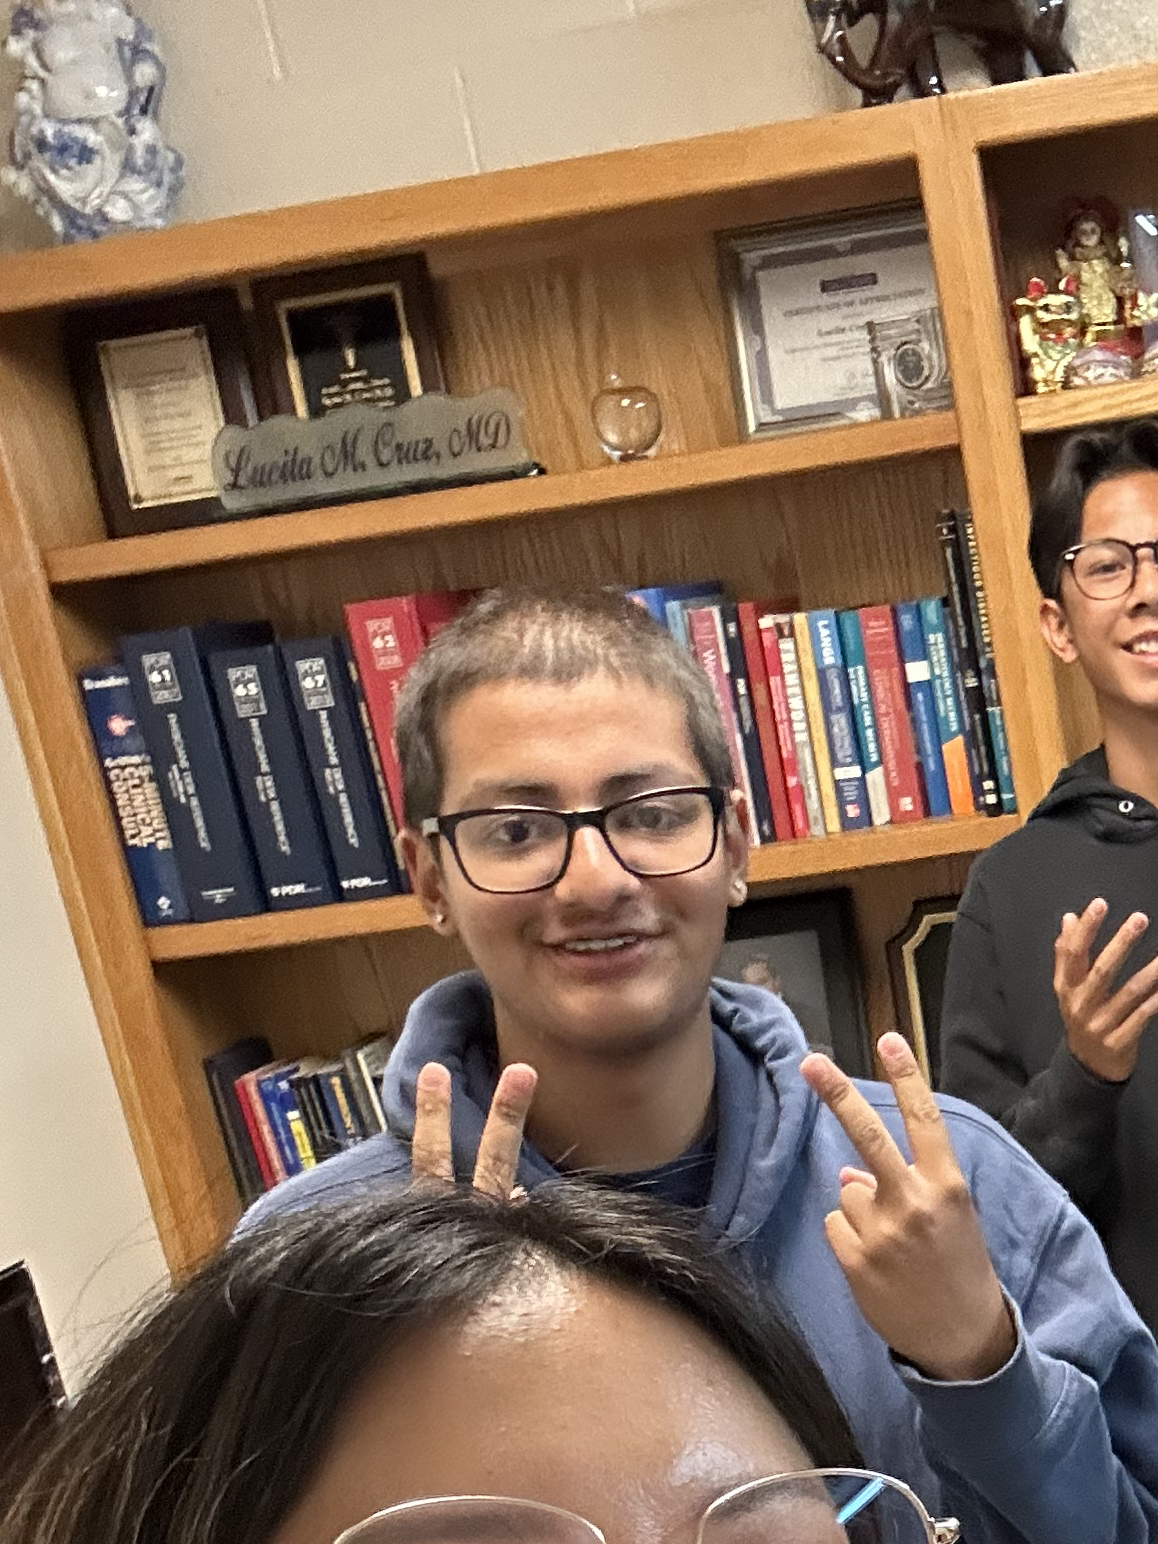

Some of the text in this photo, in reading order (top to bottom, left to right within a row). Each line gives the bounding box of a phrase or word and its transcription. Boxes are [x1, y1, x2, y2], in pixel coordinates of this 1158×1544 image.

[320, 423, 366, 479] M.
[449, 409, 512, 460] MD
[108, 767, 142, 848] CONSULT
[122, 765, 157, 848] CLINICAL
